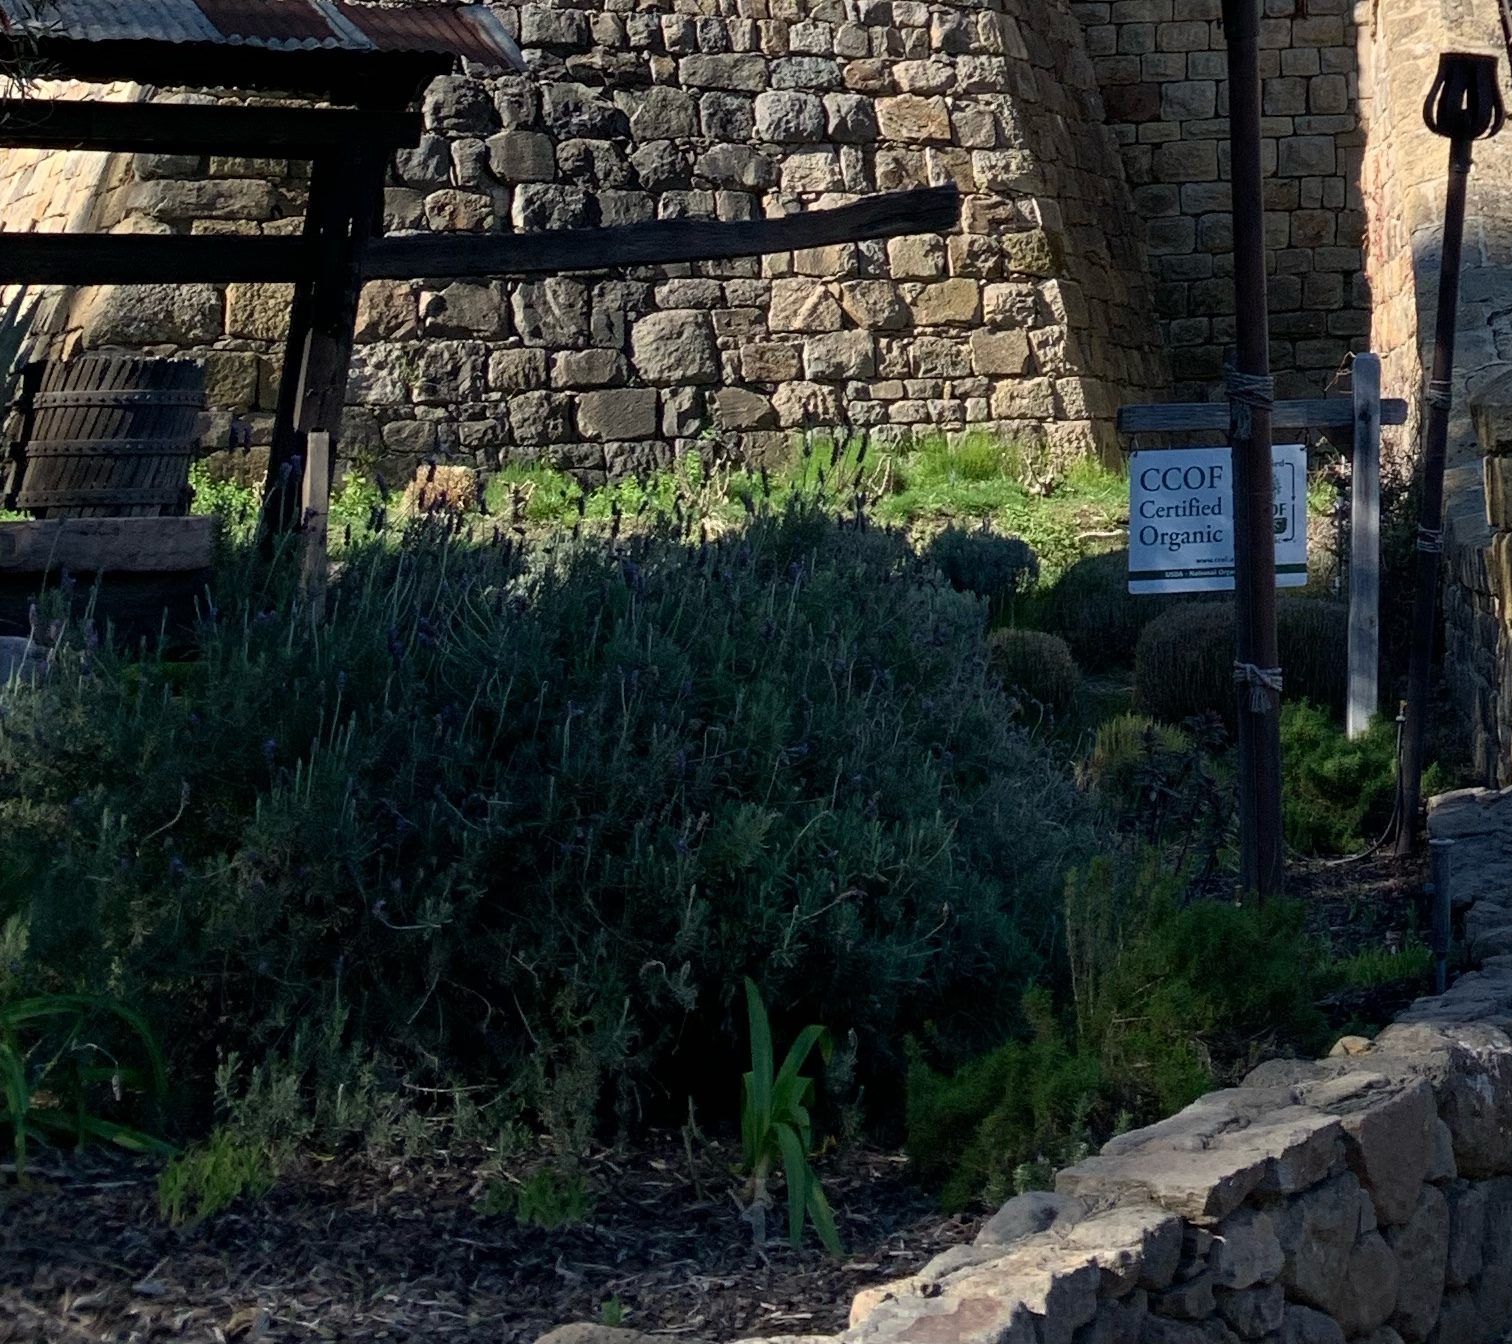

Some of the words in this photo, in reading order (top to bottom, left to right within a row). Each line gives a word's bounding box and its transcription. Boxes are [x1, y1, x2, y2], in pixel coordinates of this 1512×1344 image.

[1140, 465, 1223, 492] CCOF
[1140, 497, 1222, 519] Certified
[1140, 524, 1223, 552] Organic
